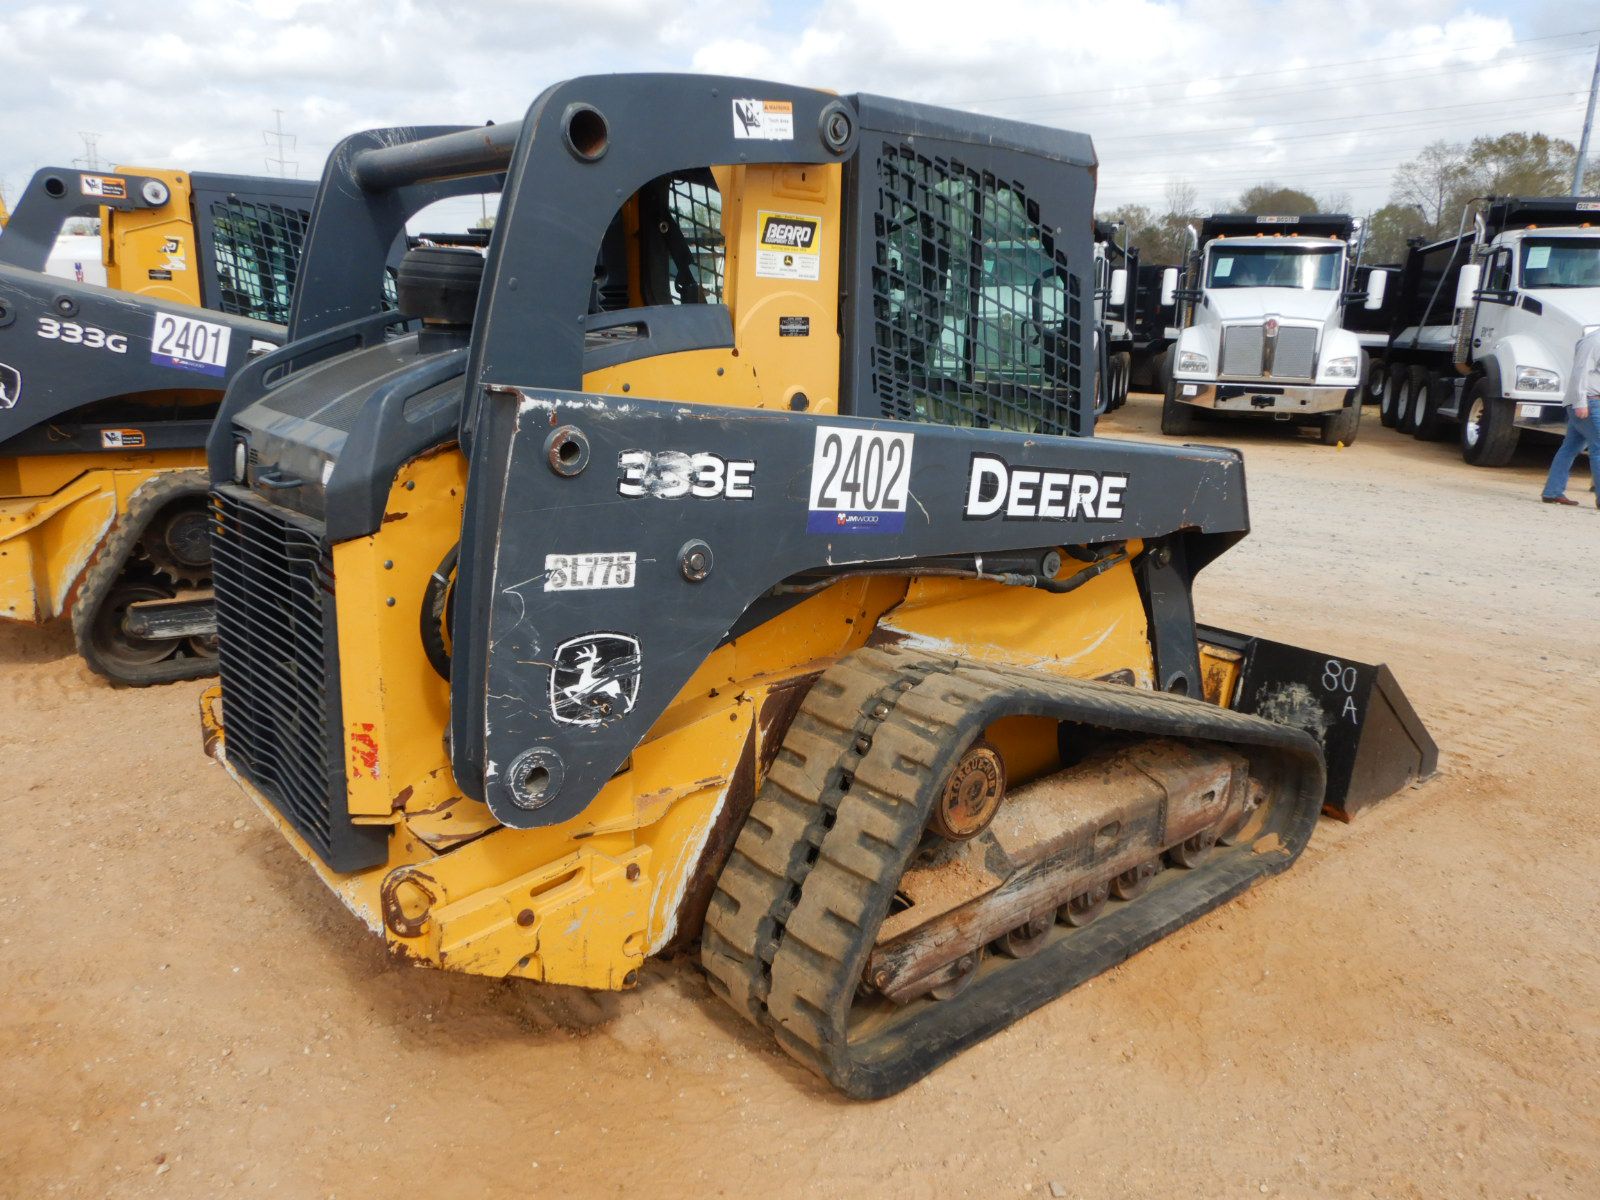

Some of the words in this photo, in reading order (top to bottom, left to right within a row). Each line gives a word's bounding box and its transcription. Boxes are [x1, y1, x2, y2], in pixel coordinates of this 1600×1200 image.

[766, 222, 812, 248] BEARD
[37, 317, 128, 354] 333G
[158, 317, 222, 363] 2401
[617, 449, 757, 500] 333E
[816, 433, 905, 511] 2402
[964, 454, 1129, 520] DEERE
[1321, 659, 1358, 693] 80
[1341, 695, 1358, 725] A
